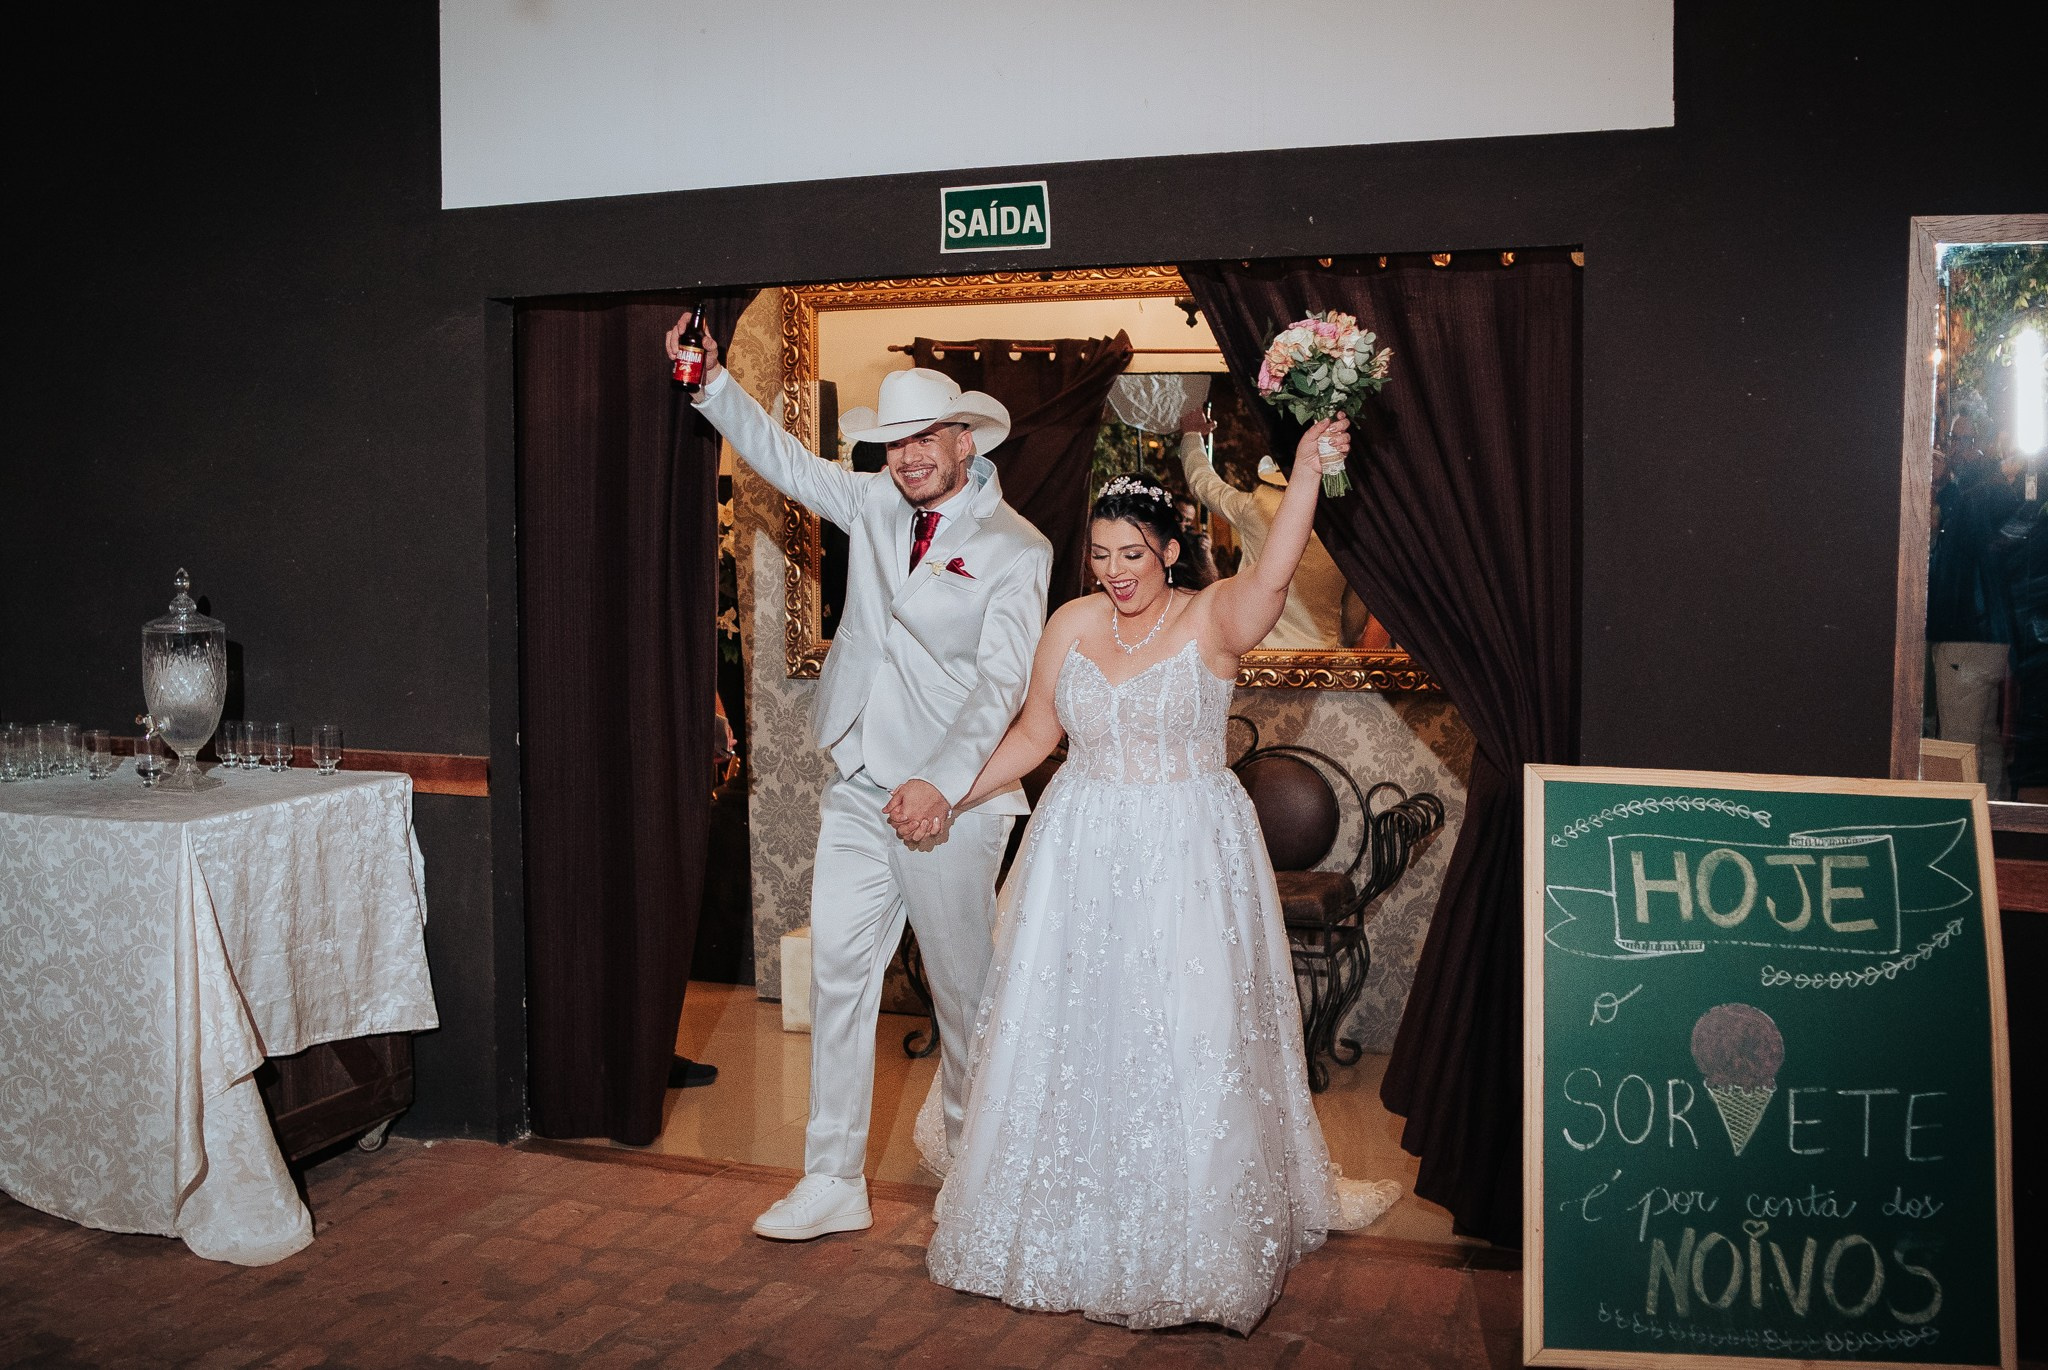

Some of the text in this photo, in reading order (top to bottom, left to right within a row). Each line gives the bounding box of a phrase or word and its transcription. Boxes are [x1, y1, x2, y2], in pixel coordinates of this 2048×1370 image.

[947, 200, 1044, 239] SAÍDA
[1632, 848, 1878, 933] HOJE
[1626, 1186, 1720, 1242] por
[1882, 1187, 1944, 1219] dos
